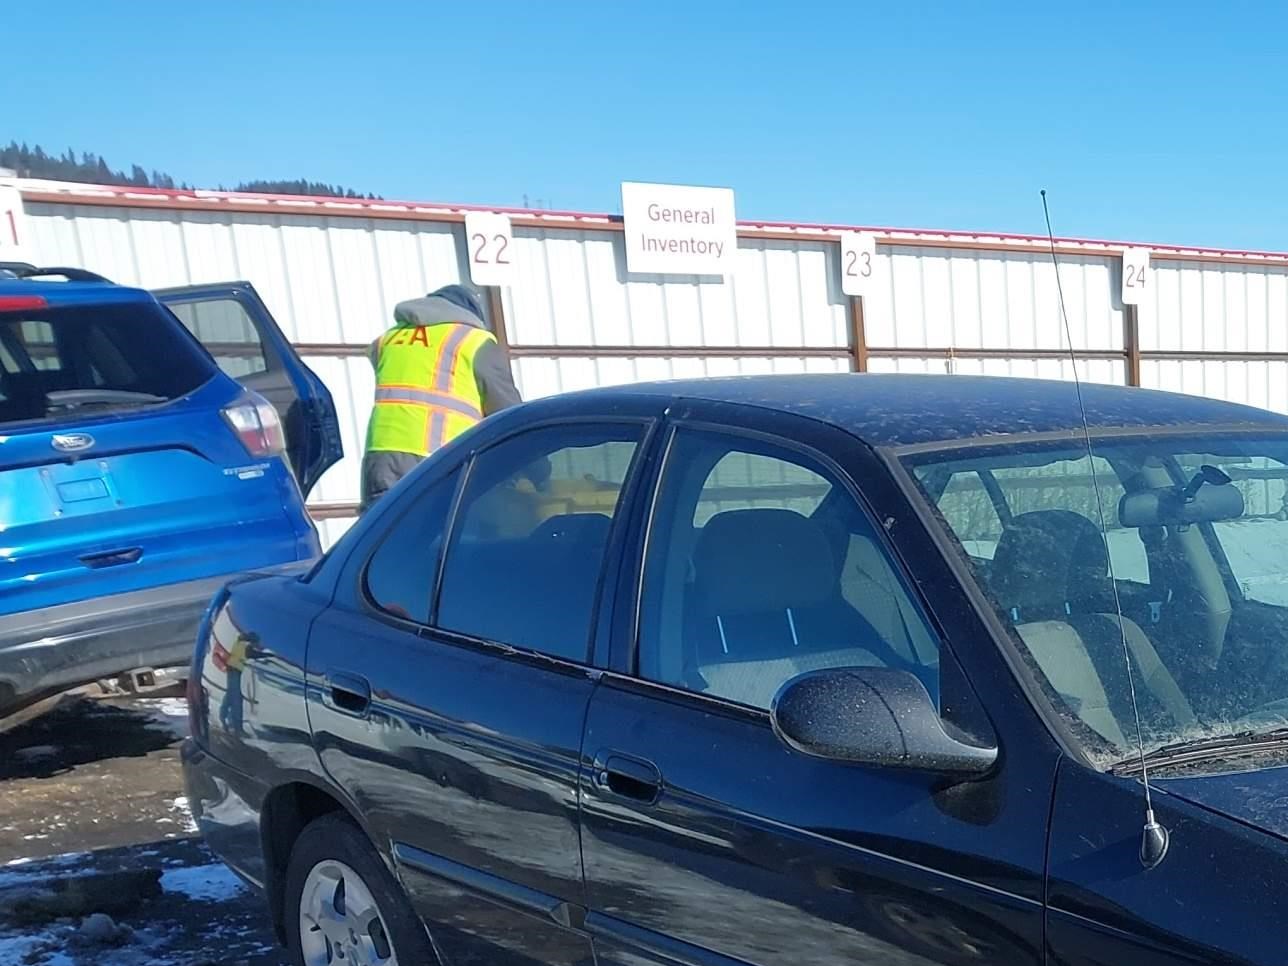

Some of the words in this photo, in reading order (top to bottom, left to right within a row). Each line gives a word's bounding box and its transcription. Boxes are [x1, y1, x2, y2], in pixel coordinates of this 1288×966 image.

[0, 208, 19, 246] 1
[647, 203, 716, 225] General
[471, 233, 510, 265] 22
[641, 233, 724, 258] Inventory
[846, 250, 872, 278] 23
[1125, 264, 1146, 289] 24
